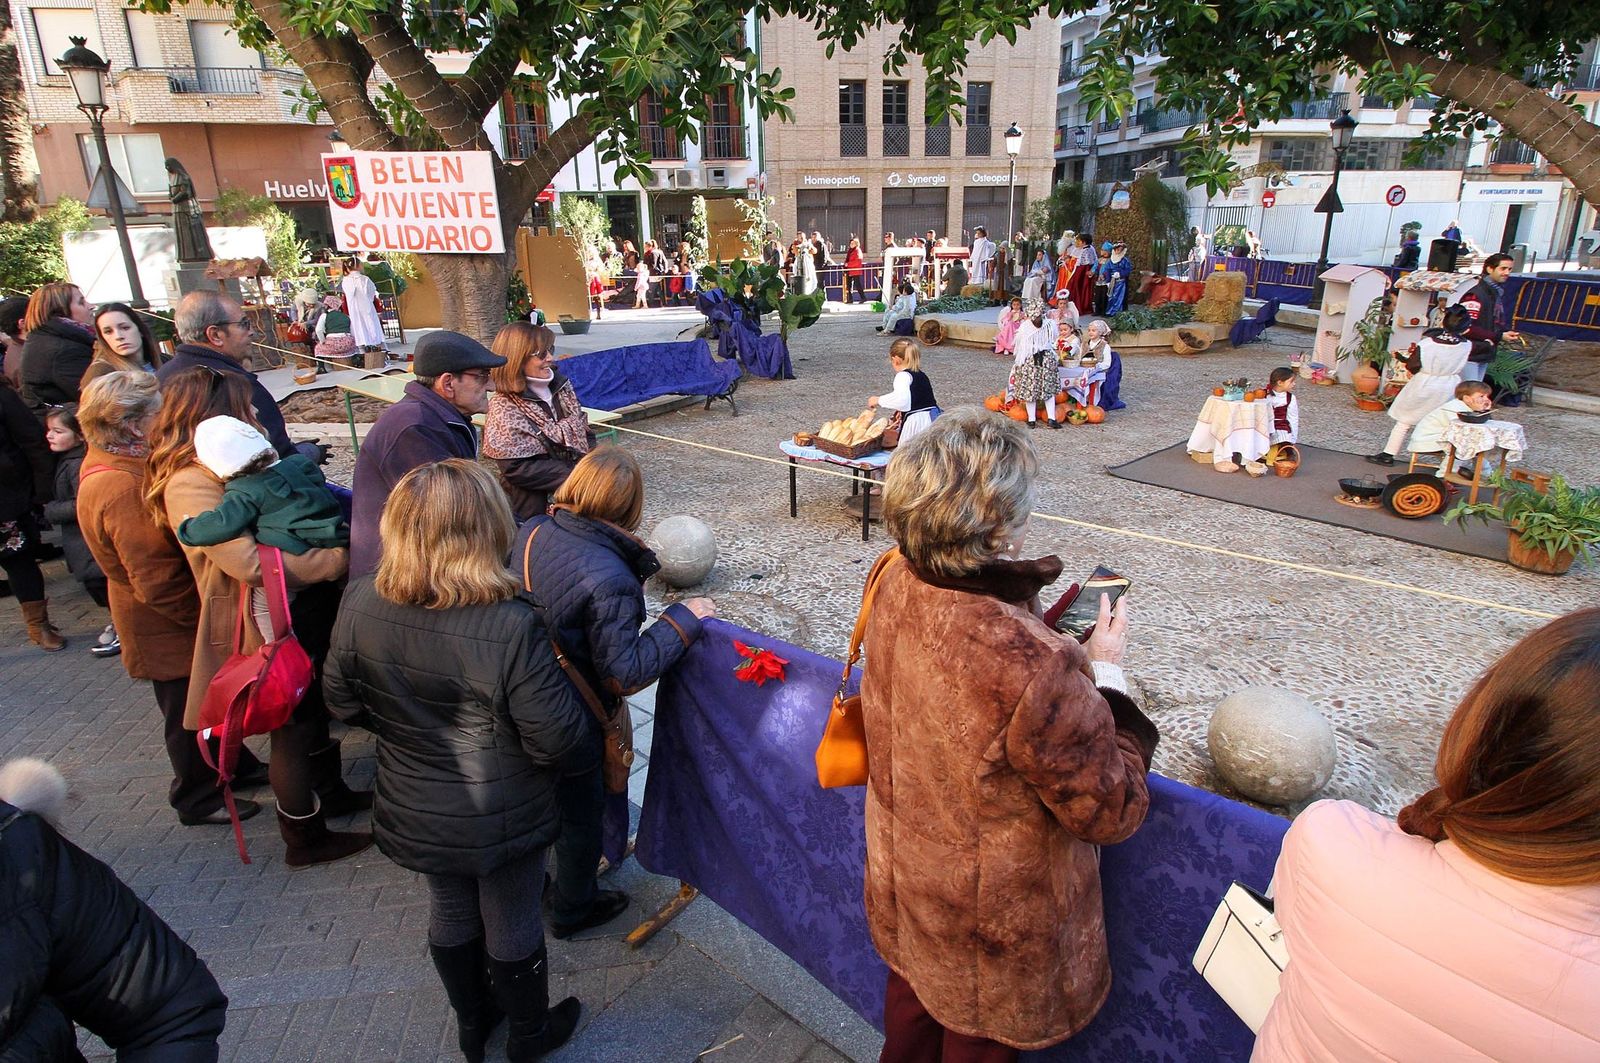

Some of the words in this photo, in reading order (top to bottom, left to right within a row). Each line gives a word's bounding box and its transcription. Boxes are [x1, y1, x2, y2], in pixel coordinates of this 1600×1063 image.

[370, 156, 464, 184] BELEN
[907, 173, 946, 185] Synergia
[972, 173, 1018, 184] Osteopata
[361, 192, 496, 219] VIVIENTE
[344, 222, 493, 251] SOLIDARIO
